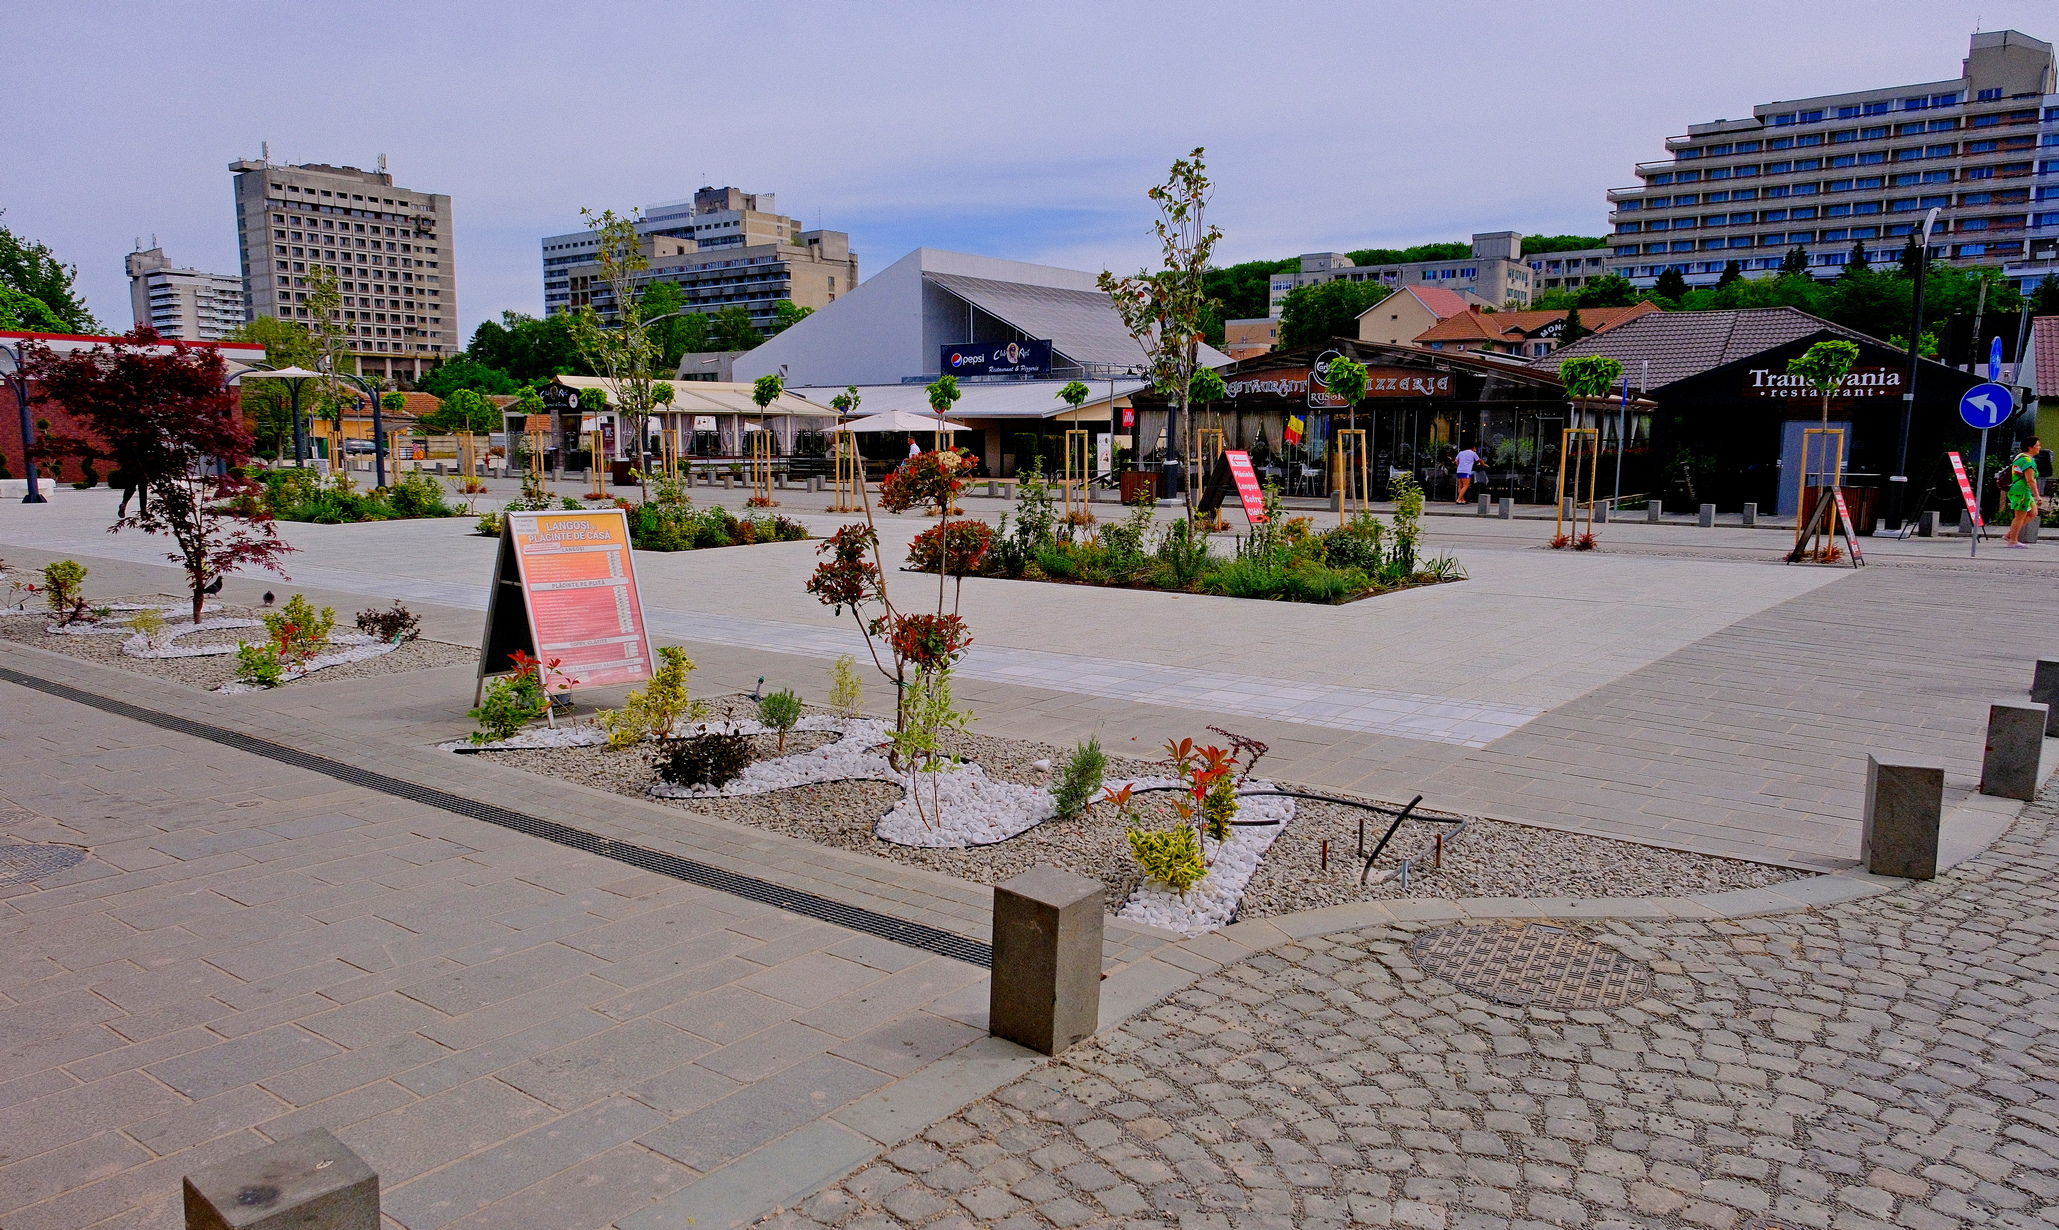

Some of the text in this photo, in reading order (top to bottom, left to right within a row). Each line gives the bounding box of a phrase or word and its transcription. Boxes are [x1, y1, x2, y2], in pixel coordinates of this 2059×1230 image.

[962, 354, 985, 365] pepsi
[1365, 376, 1449, 396] IZZERIE
[574, 531, 586, 540] DE
